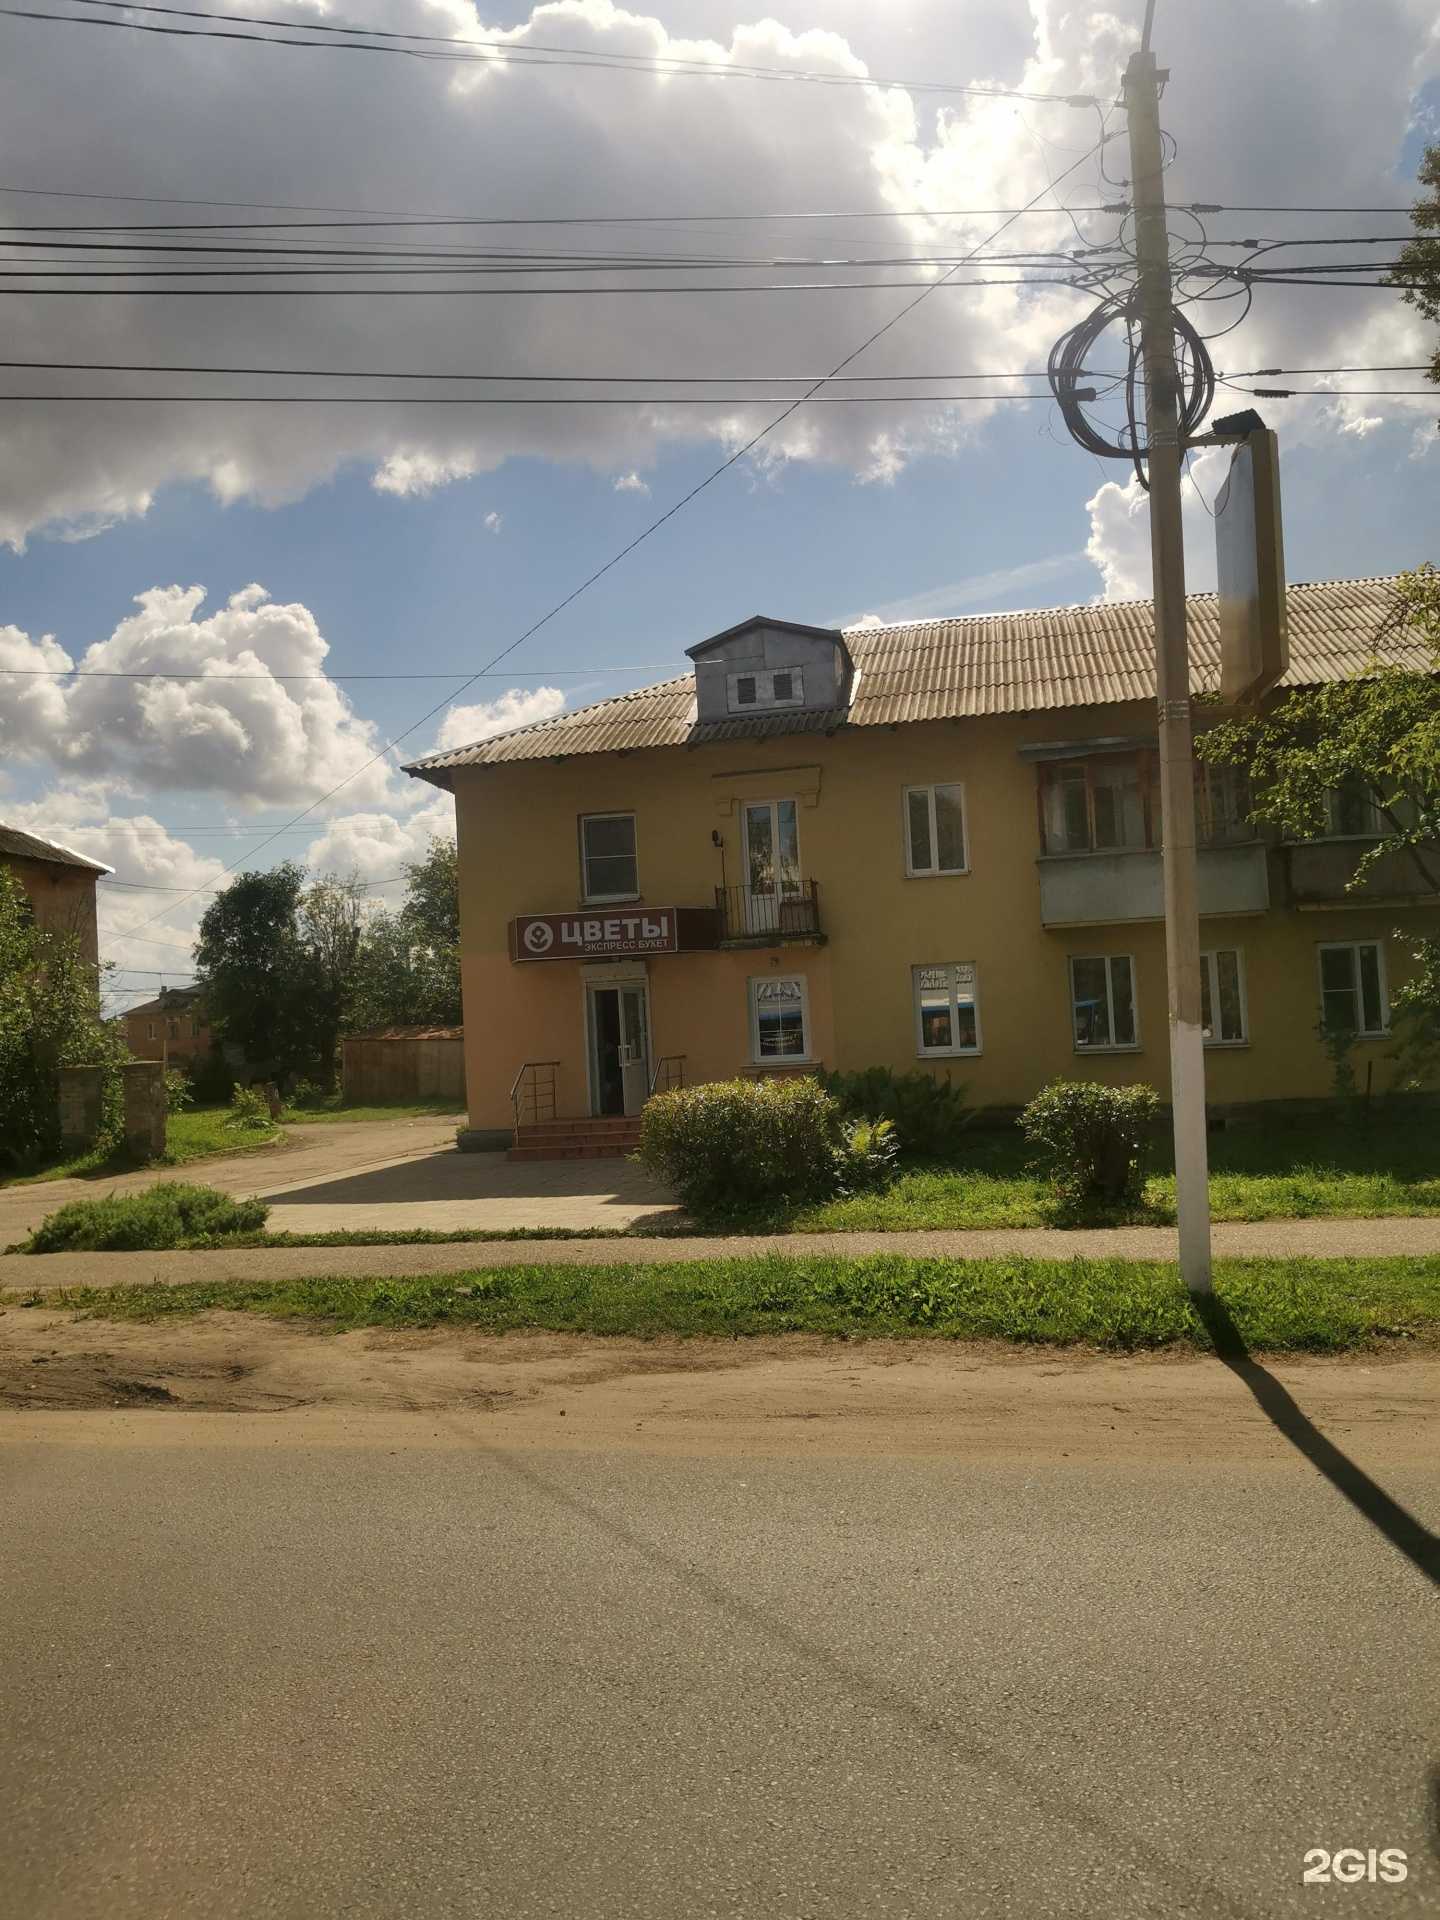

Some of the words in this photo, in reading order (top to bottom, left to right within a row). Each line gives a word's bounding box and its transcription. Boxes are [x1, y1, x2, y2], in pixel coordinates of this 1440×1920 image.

[560, 916, 669, 946] ЦВЕТЫ
[584, 941, 636, 952] ЭКСПРЕСС
[638, 938, 669, 949] БУКЕТ
